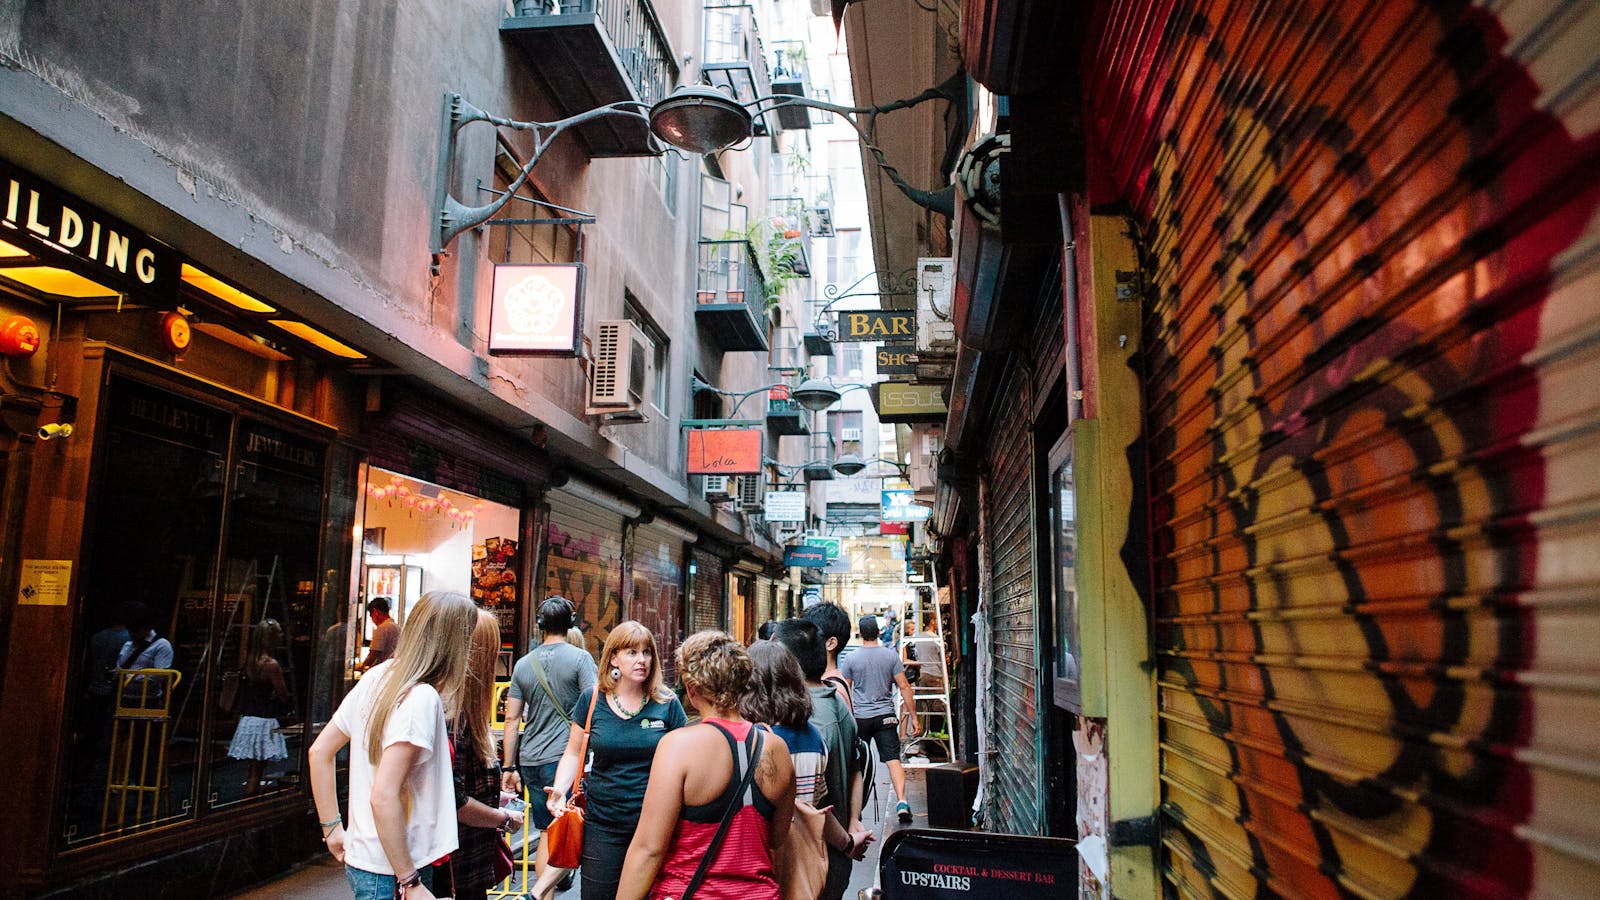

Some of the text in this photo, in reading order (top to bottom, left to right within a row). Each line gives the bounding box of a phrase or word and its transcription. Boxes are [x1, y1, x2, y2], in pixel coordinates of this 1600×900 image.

[6, 178, 156, 284] ILDING
[246, 433, 319, 466] JEWELLERY
[900, 871, 971, 891] UPSTAIRS
[933, 863, 1055, 884] COCKTAIL & DESSERT BAR
